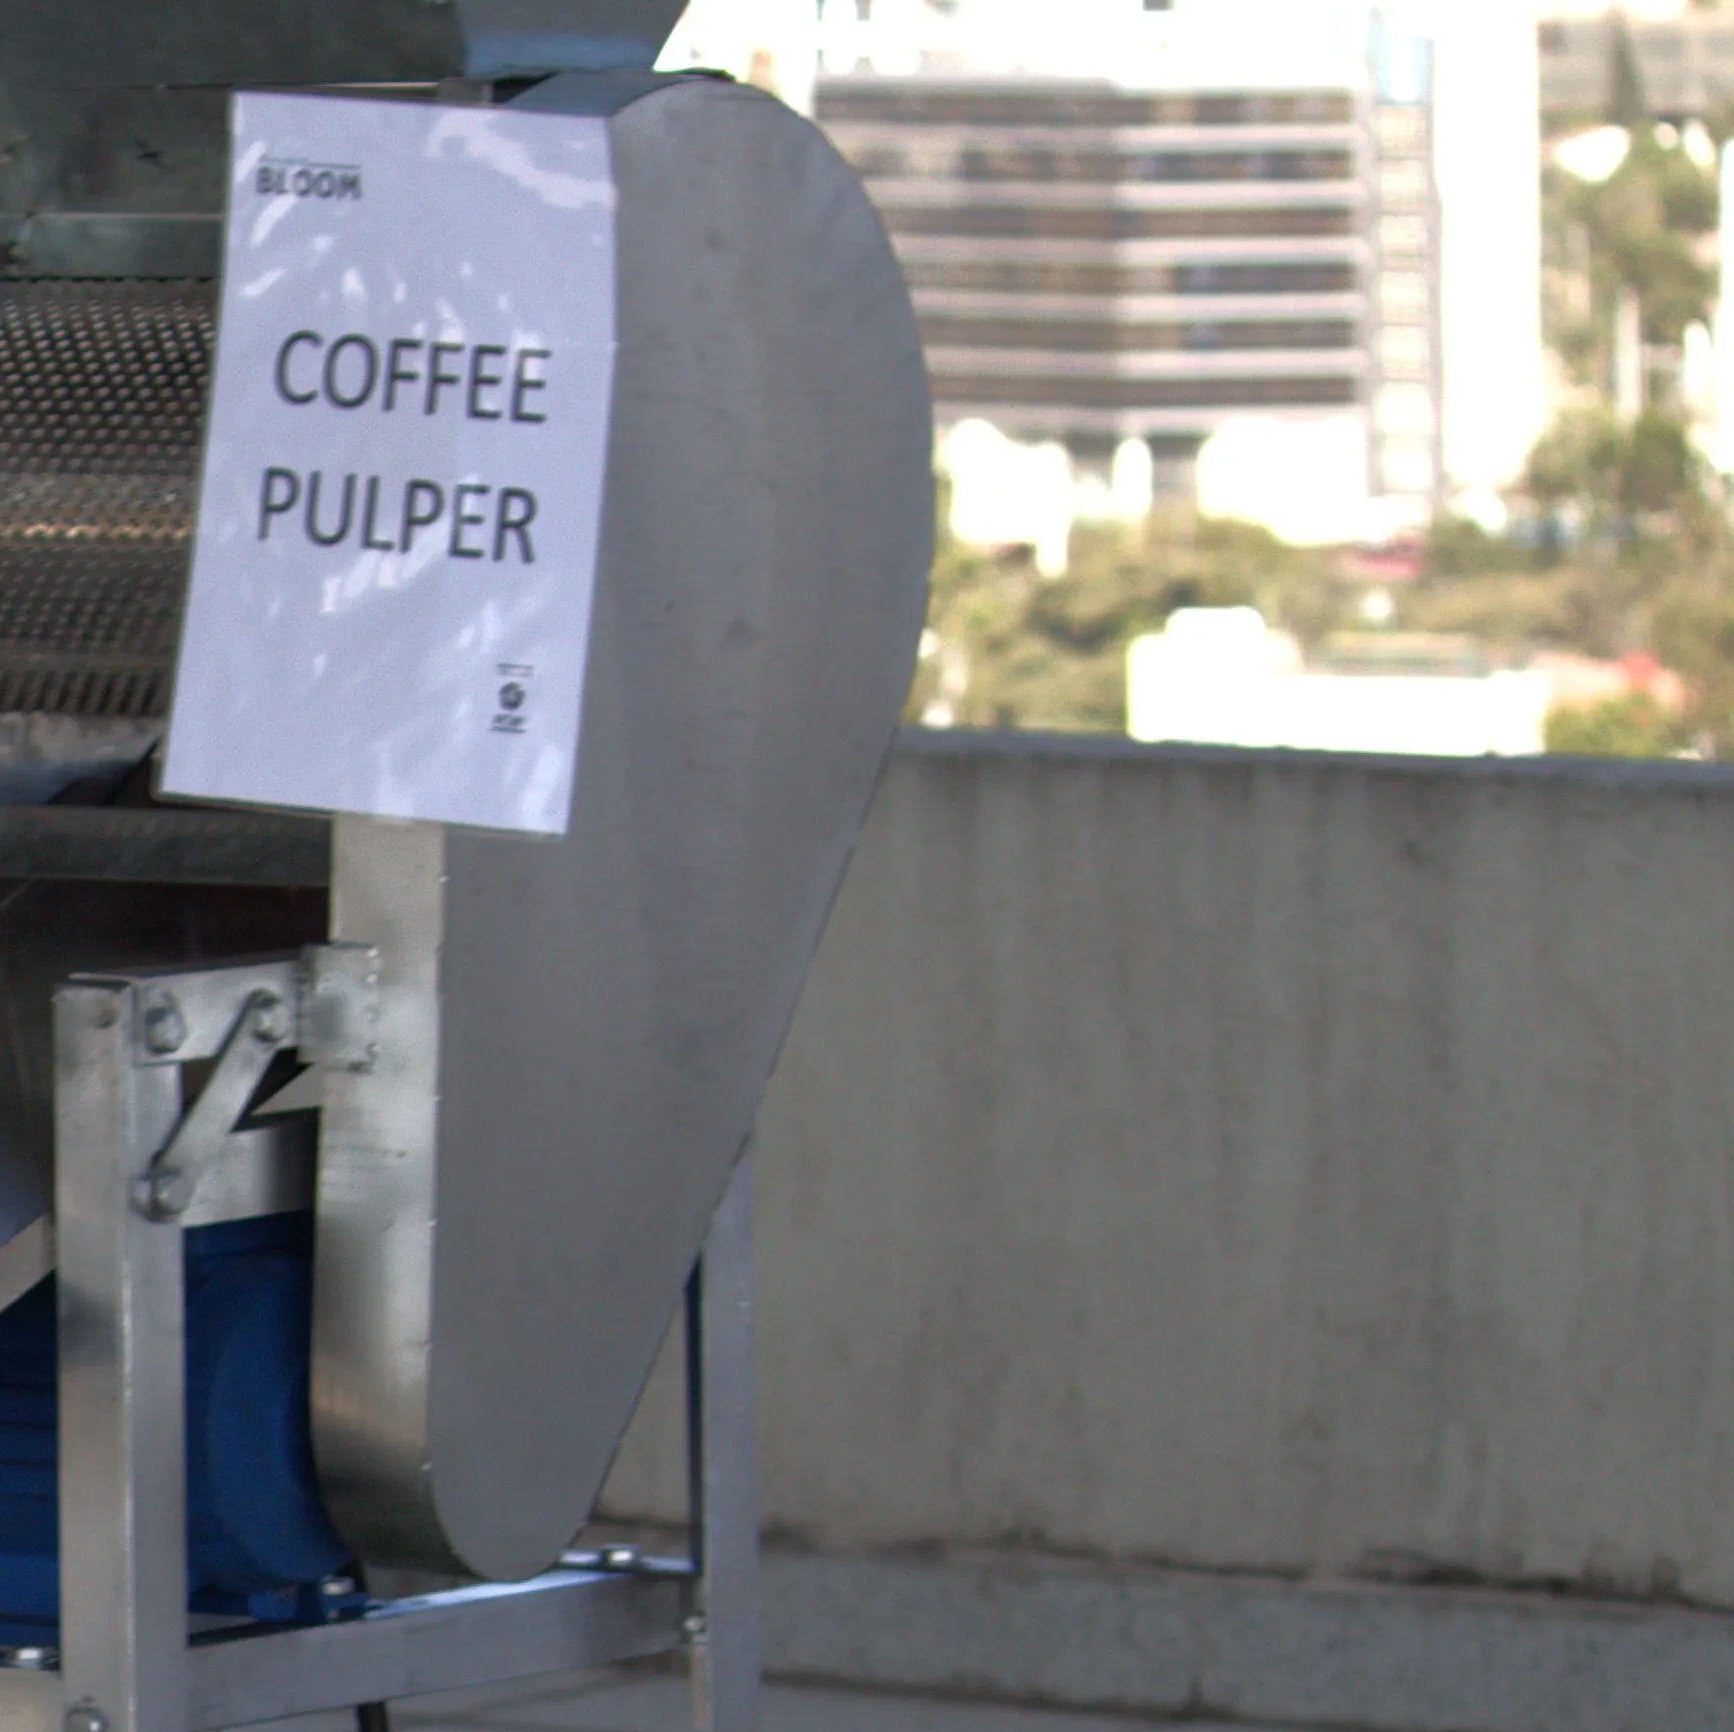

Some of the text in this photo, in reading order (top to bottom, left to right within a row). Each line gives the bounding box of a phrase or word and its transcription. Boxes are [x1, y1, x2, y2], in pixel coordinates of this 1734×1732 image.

[254, 164, 361, 200] BLOOM
[273, 329, 552, 424] COFFEE
[257, 467, 538, 564] PULPER
